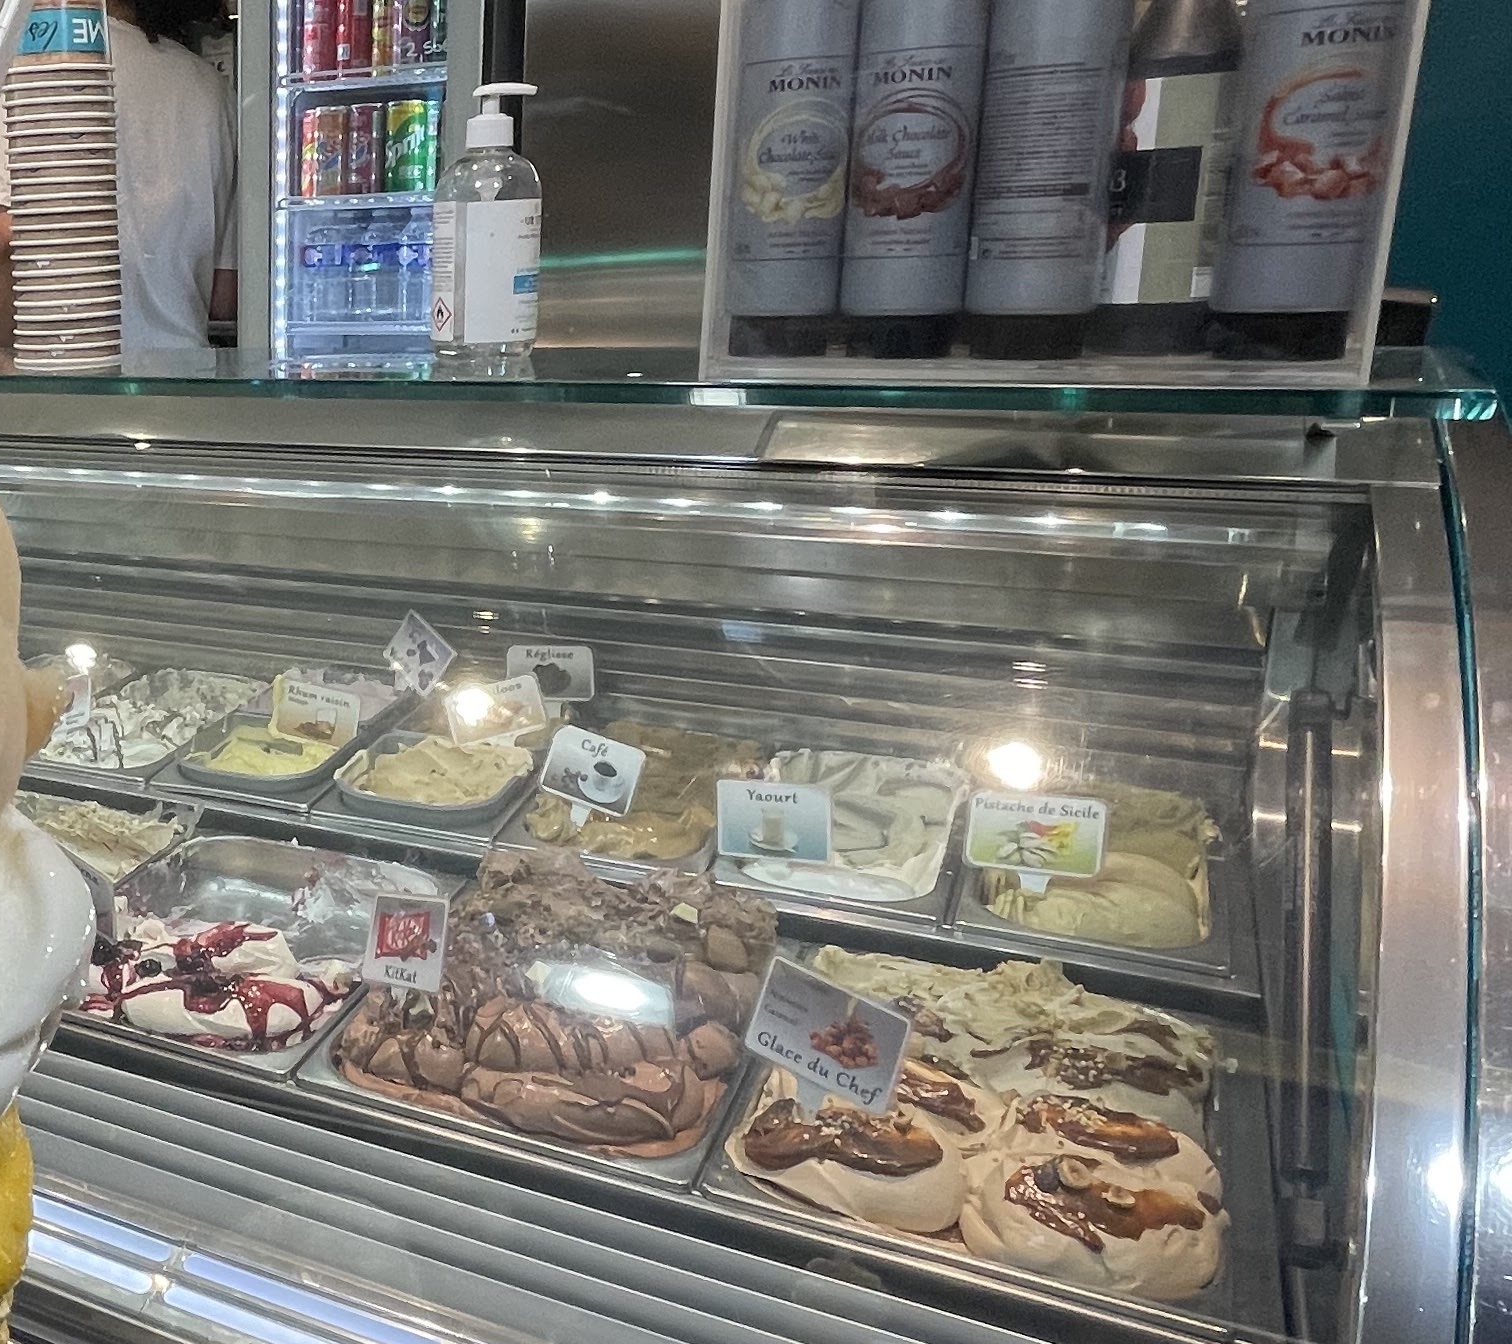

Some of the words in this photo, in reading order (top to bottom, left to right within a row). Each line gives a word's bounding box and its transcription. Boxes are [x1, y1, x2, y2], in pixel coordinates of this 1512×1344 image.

[767, 74, 842, 94] MONIN
[873, 64, 953, 86] MONIN
[581, 738, 609, 759] Café
[745, 788, 799, 804] Yaourt
[974, 797, 1035, 814] Pistache
[1038, 801, 1057, 816] de
[1059, 804, 1100, 820] Sicile
[757, 1031, 803, 1064] Glace
[807, 1056, 829, 1079] du
[836, 1071, 883, 1106] Chef
